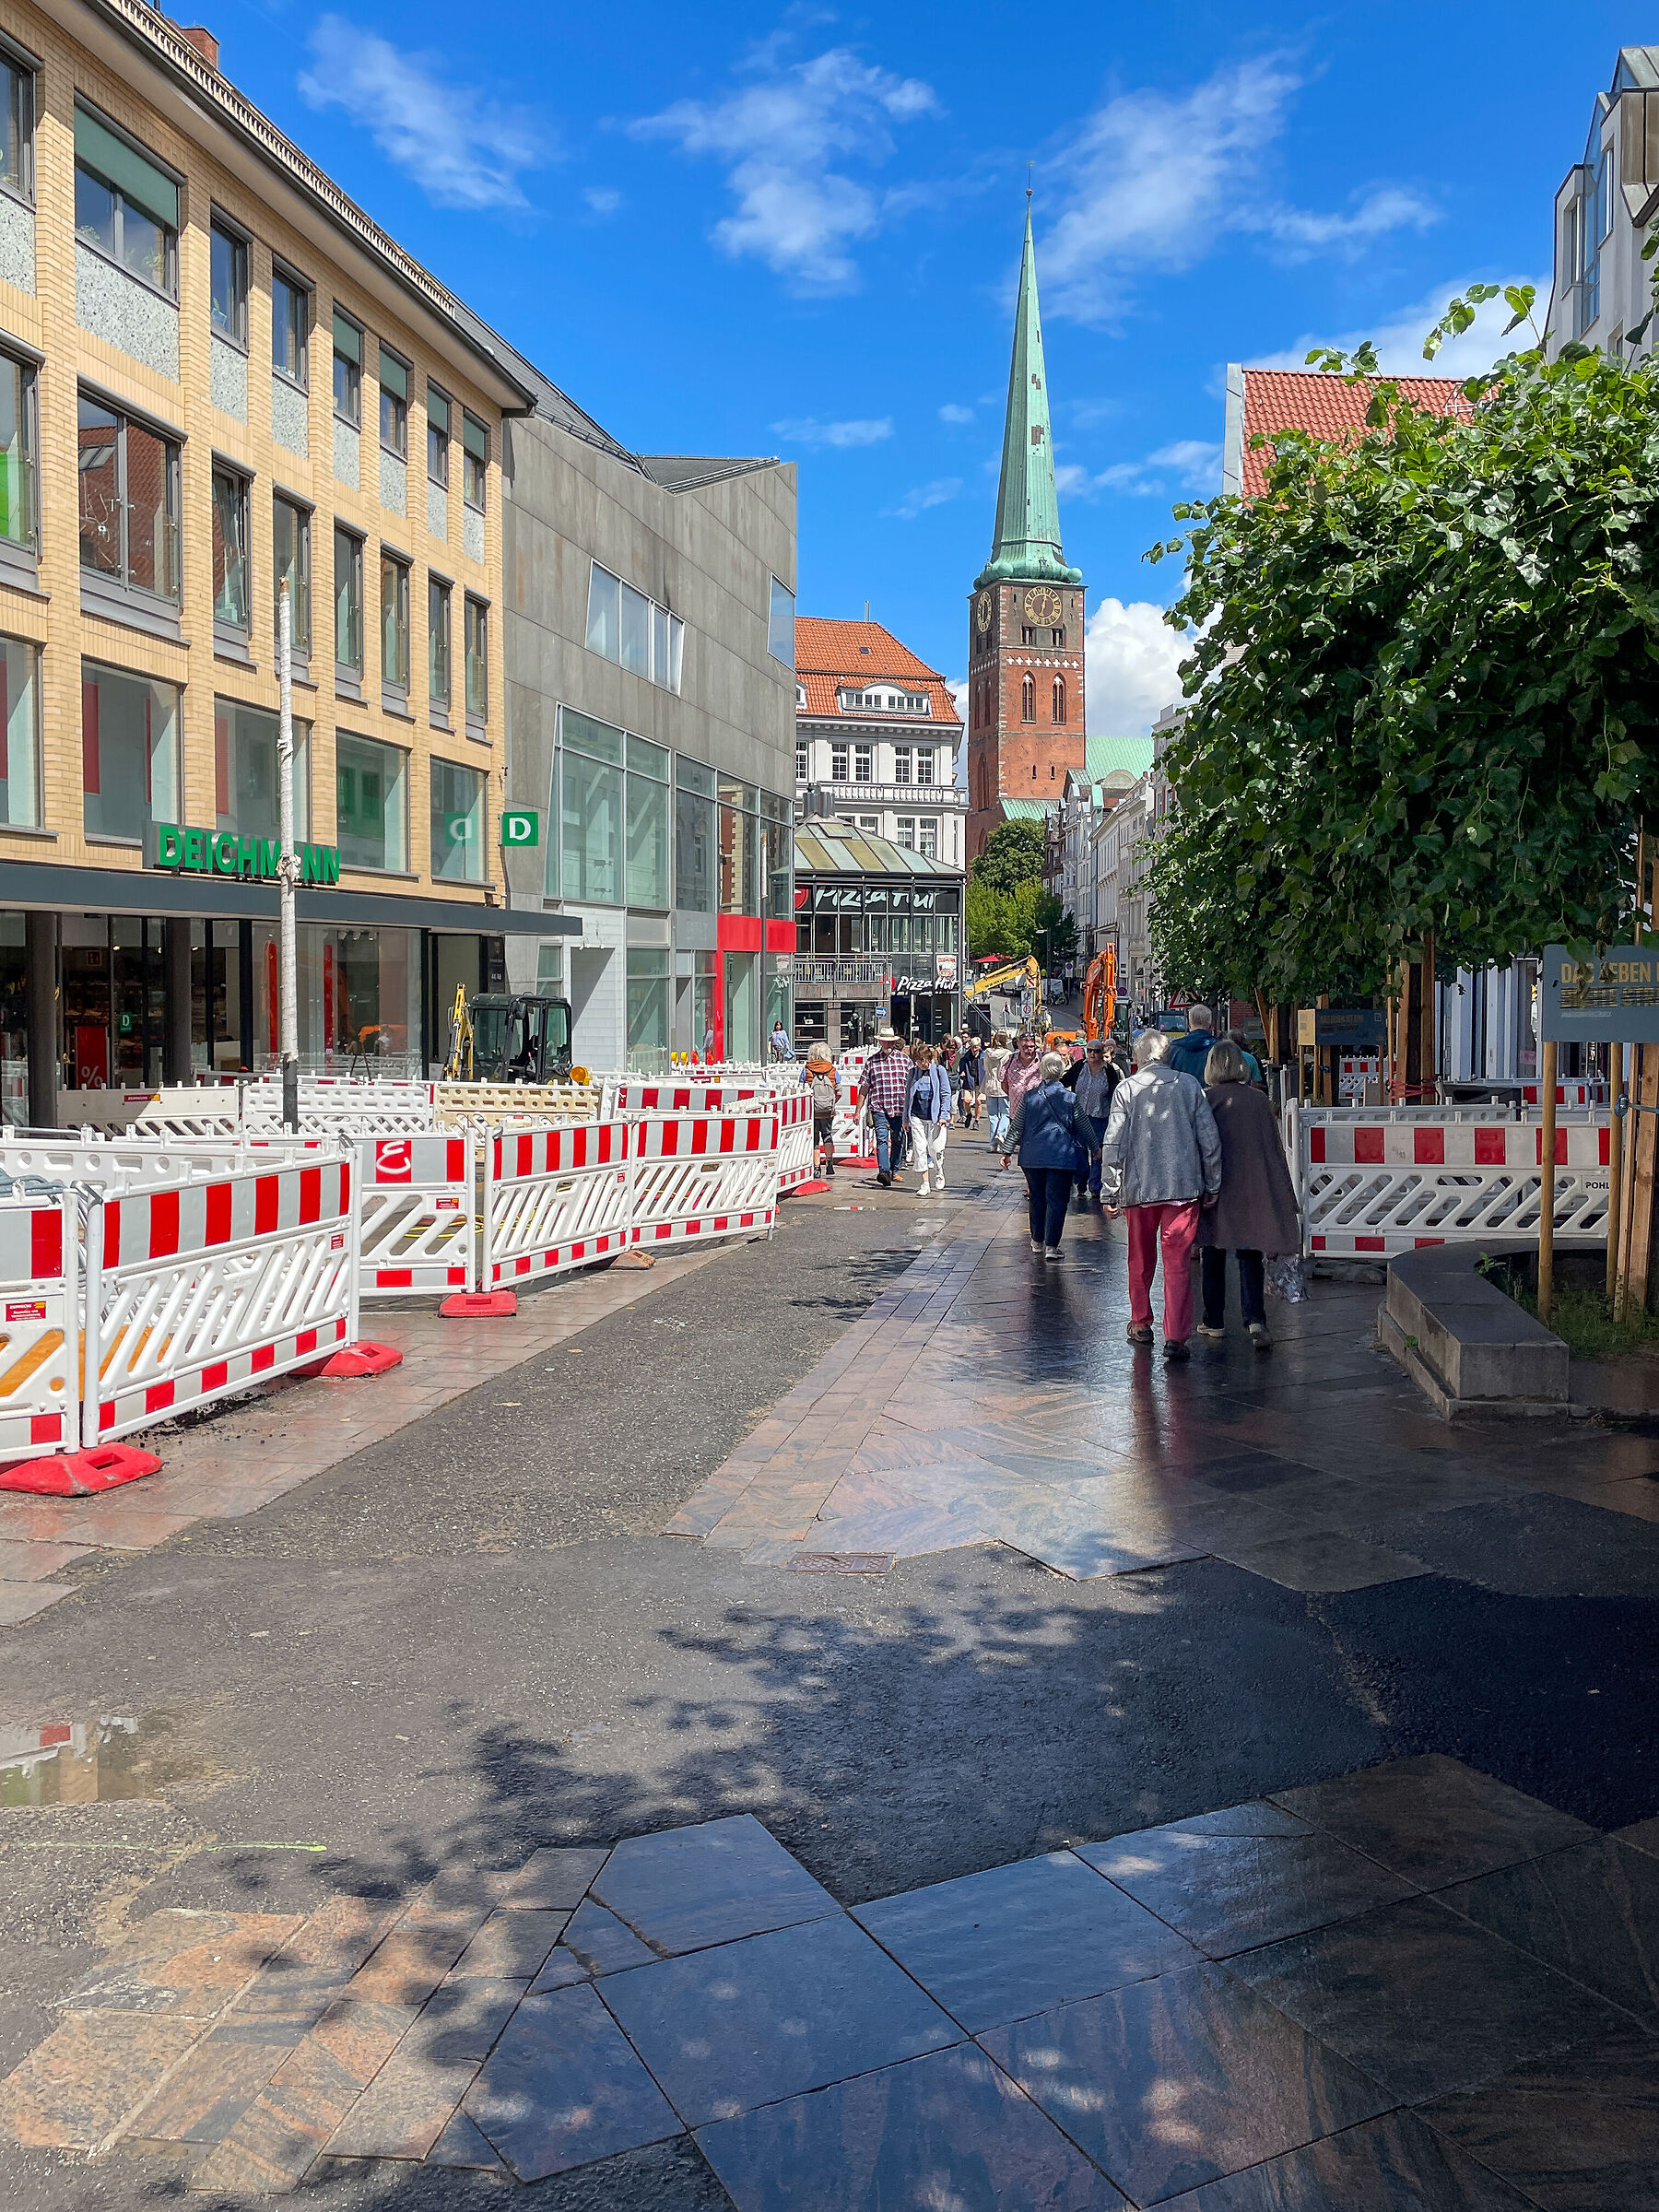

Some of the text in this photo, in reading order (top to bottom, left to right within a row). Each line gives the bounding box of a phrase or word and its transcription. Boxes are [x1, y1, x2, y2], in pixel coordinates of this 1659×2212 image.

[510, 818, 531, 840] D
[159, 825, 340, 882] DEICHMNN
[897, 976, 959, 992] Pizza Hut
